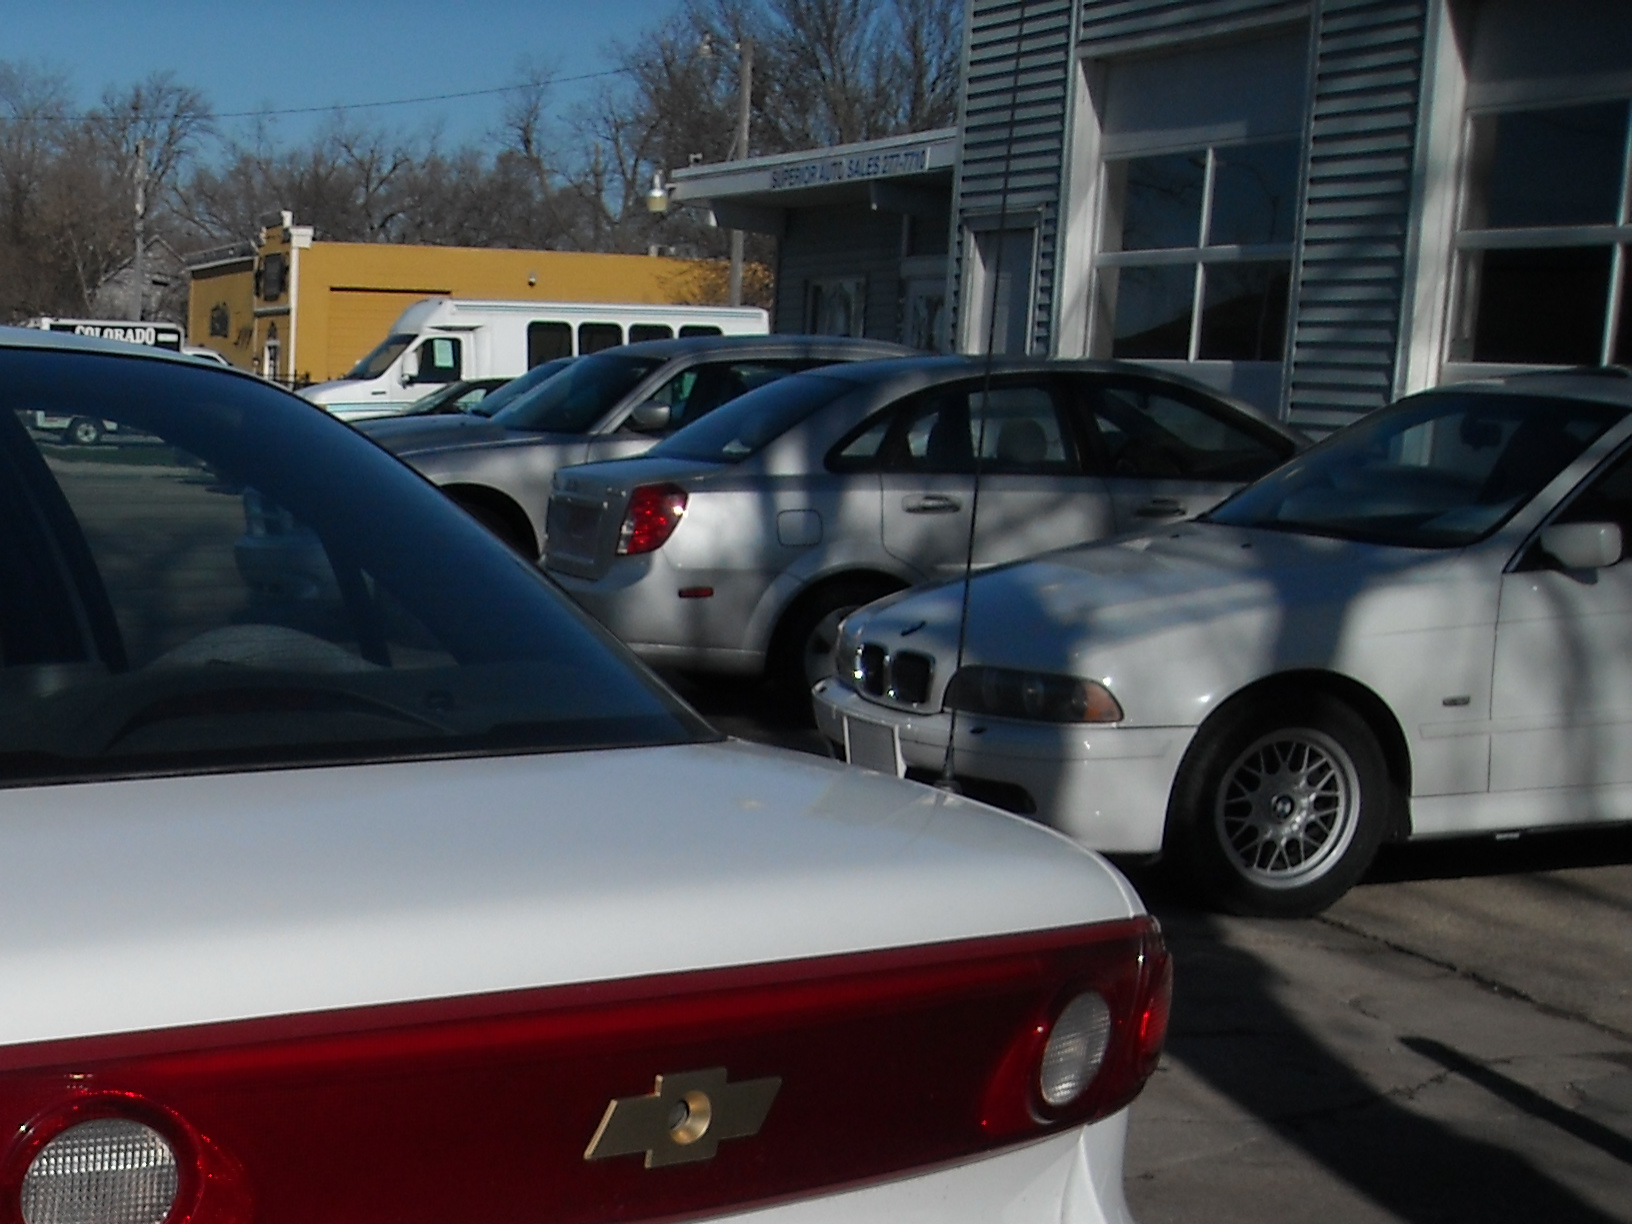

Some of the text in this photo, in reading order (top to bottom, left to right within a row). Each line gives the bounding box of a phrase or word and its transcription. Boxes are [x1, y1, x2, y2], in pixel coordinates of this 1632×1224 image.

[771, 165, 817, 189] SUPERIOR
[819, 160, 843, 182] AUTO
[846, 155, 880, 178] SALES
